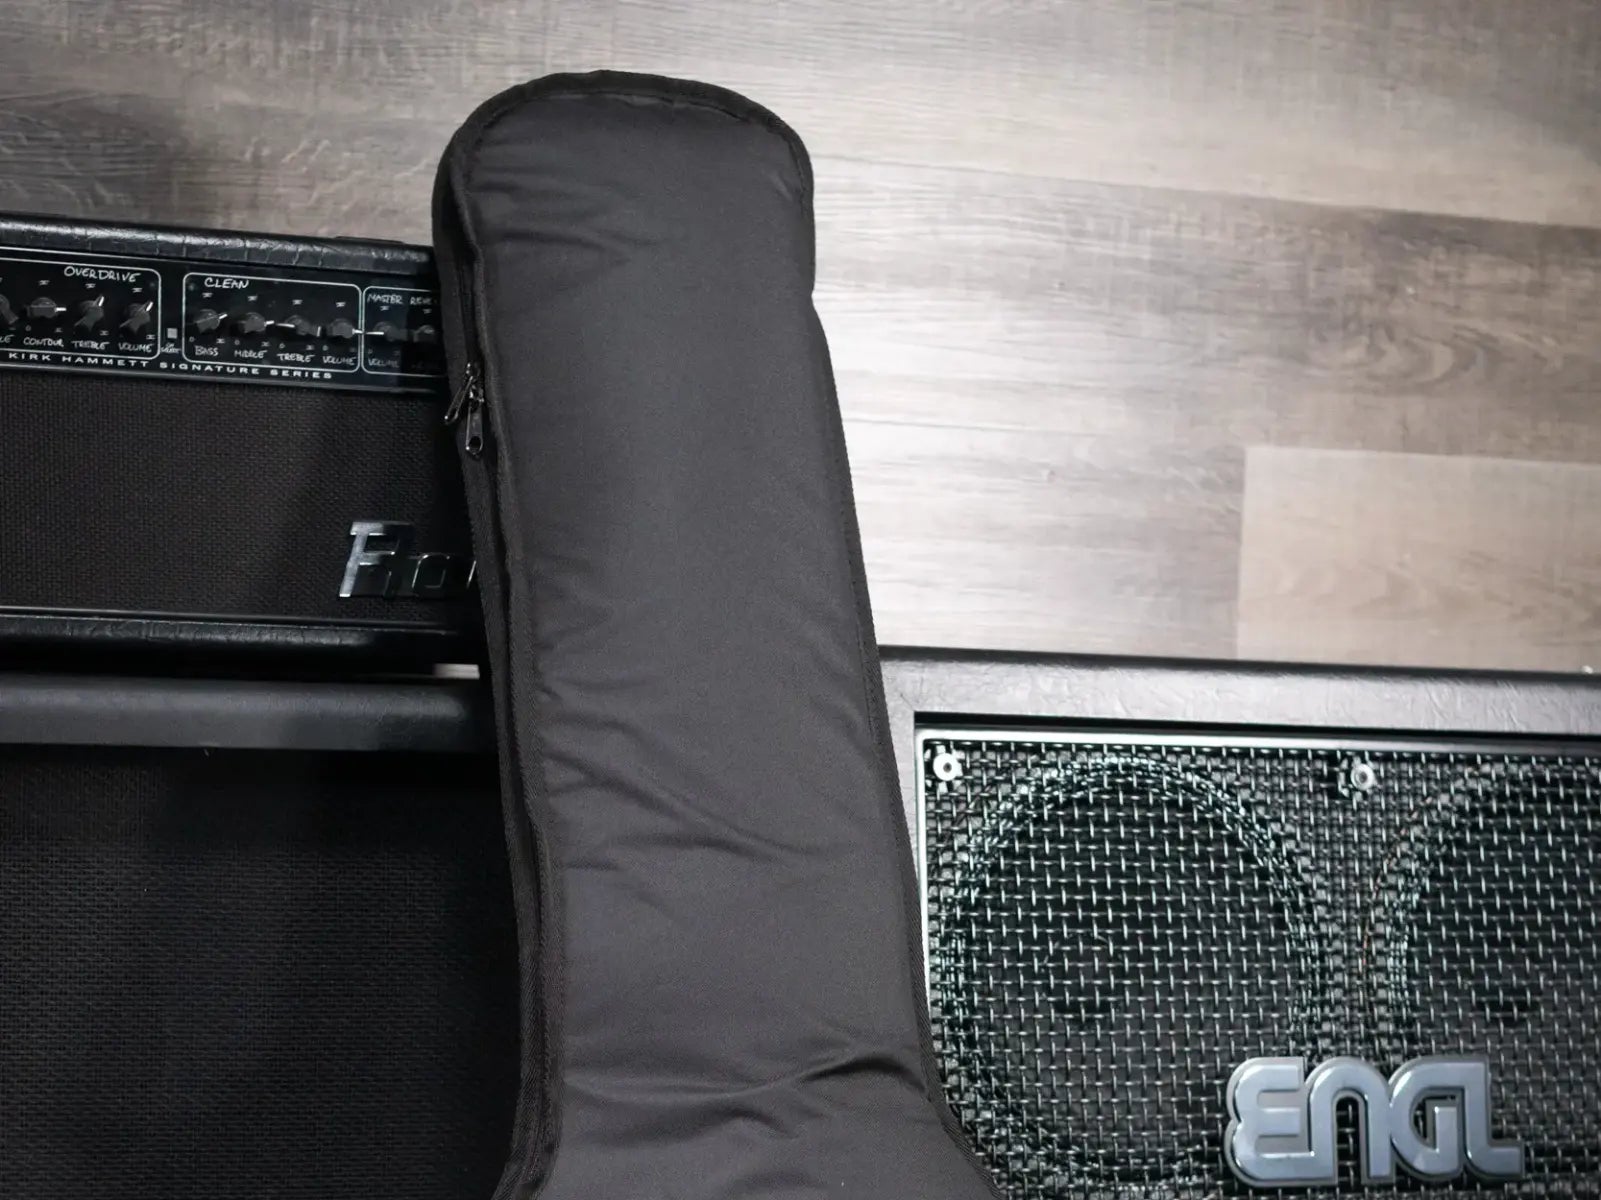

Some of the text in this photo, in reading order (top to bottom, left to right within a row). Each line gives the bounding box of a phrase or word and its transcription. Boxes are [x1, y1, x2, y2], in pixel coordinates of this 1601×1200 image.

[64, 266, 141, 282] OVERDRIVE
[204, 277, 249, 289] CLEAN
[367, 293, 403, 305] MASTER
[23, 337, 65, 347] CONTOUR
[71, 340, 110, 350] TREBLE
[119, 342, 155, 353] VOLUME
[194, 345, 219, 357] BASS
[234, 350, 268, 359] MIDDLE
[277, 353, 316, 363] TREBLE
[322, 355, 357, 366] VOLUME
[8, 352, 332, 379] KIRK HAMMETT SIGNATURE SERIES
[1224, 1056, 1525, 1188] ENGL
